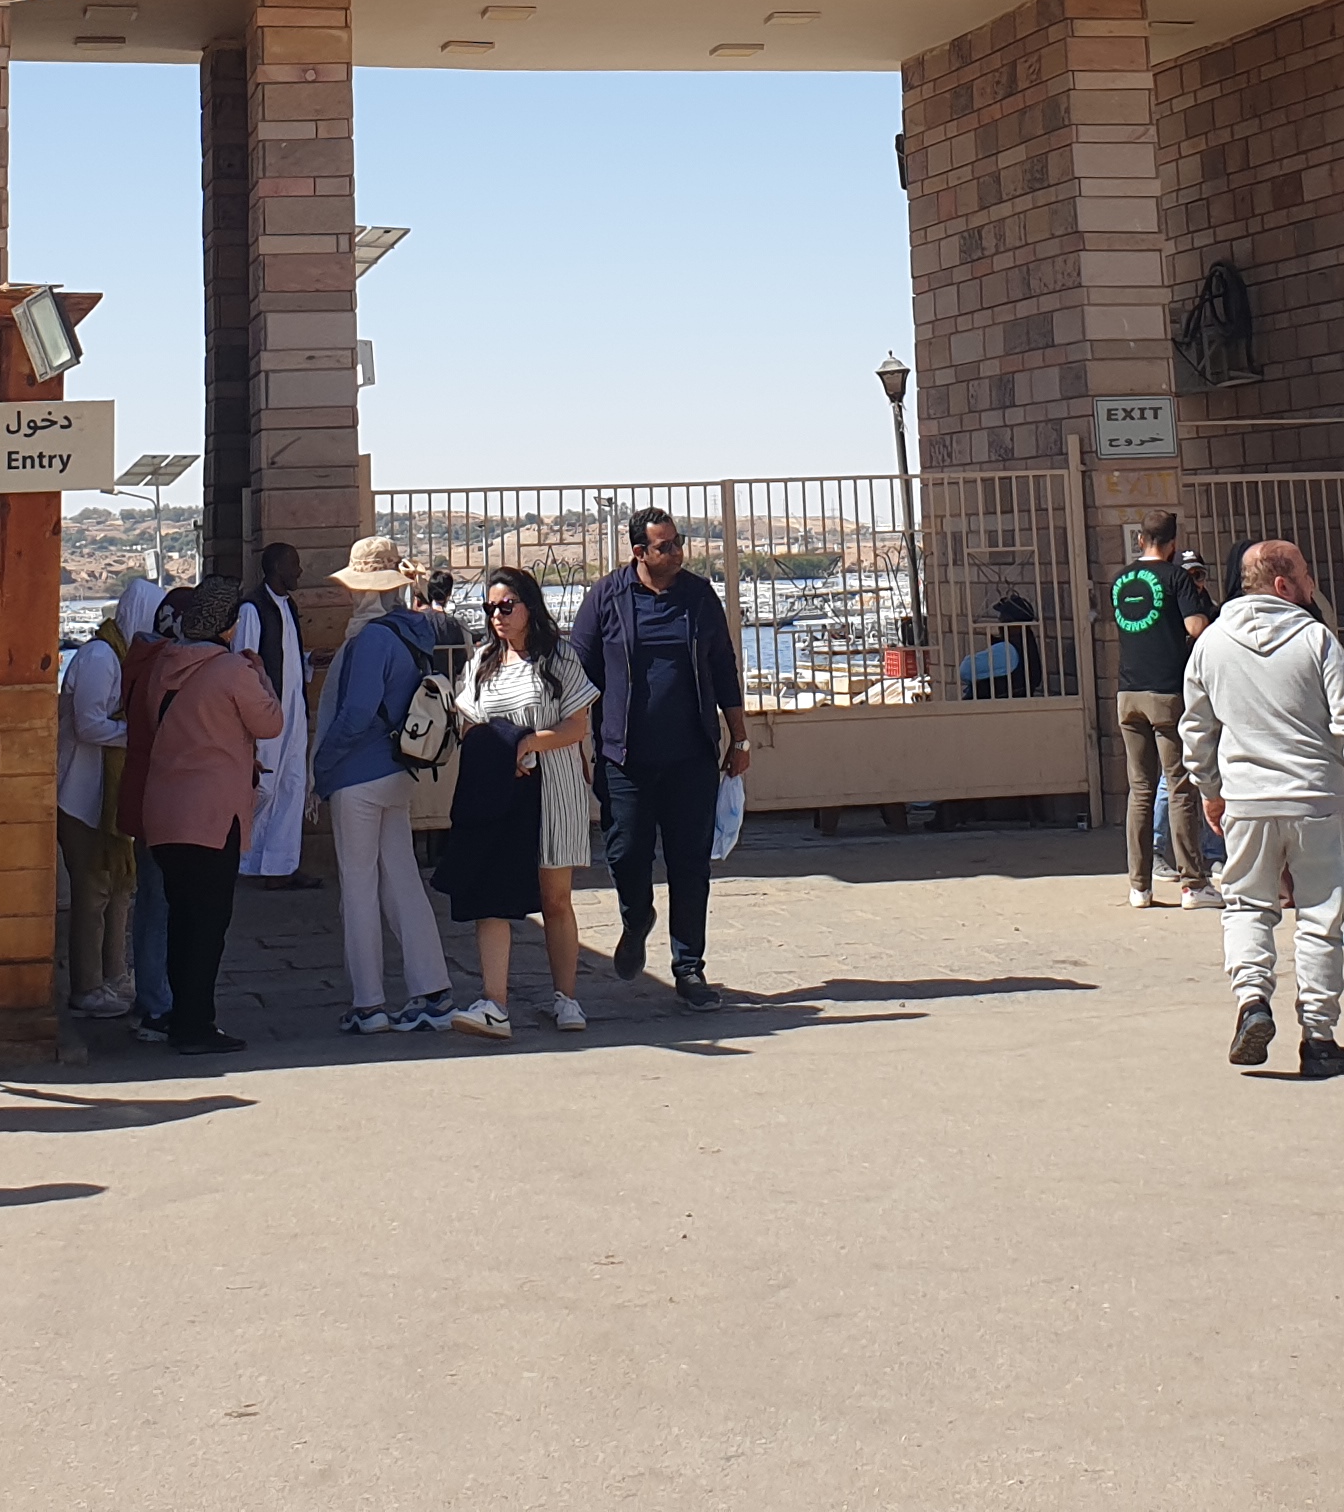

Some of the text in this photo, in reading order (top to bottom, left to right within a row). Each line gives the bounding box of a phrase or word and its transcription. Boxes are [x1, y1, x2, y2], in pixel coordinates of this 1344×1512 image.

[6, 410, 73, 438] دخول
[1106, 406, 1163, 422] EXIT
[1107, 432, 1165, 448] خروج
[7, 450, 72, 474] Entry
